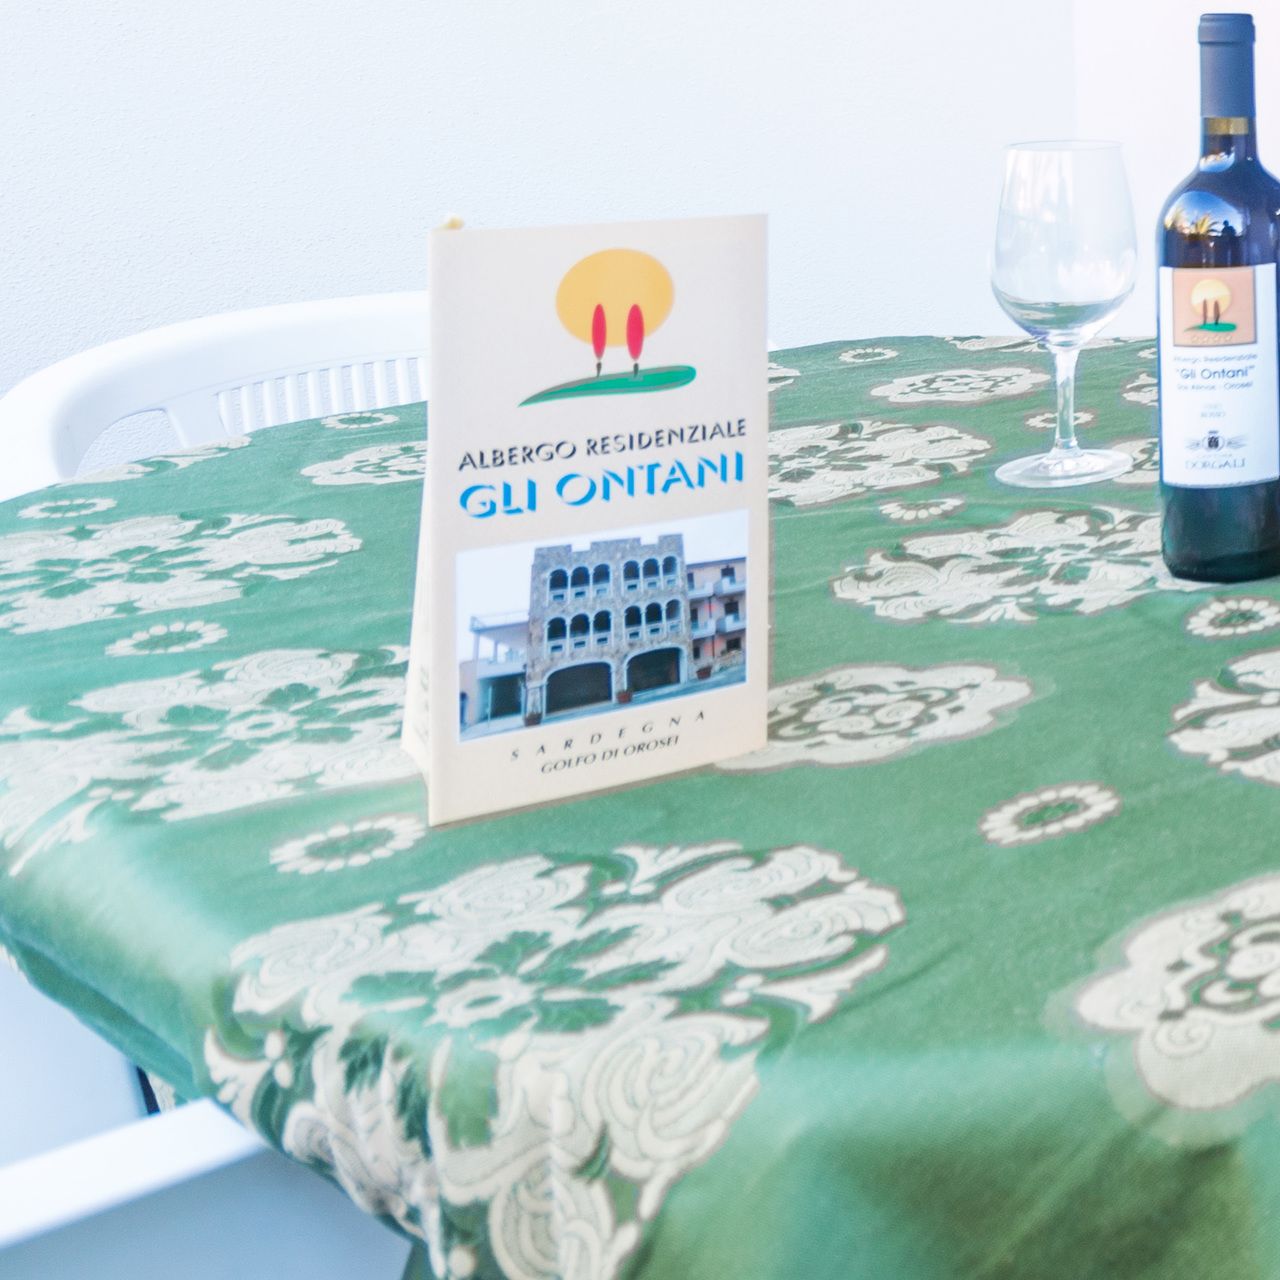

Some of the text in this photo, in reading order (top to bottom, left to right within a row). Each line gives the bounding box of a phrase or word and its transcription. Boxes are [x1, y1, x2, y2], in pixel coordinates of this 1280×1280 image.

[458, 418, 747, 472] ALBERGO RESIDENZIALE
[459, 451, 744, 519] GLI ONTANI
[510, 709, 706, 762] SARDEGNA
[540, 734, 680, 775] GOLFO DI OROSEI
